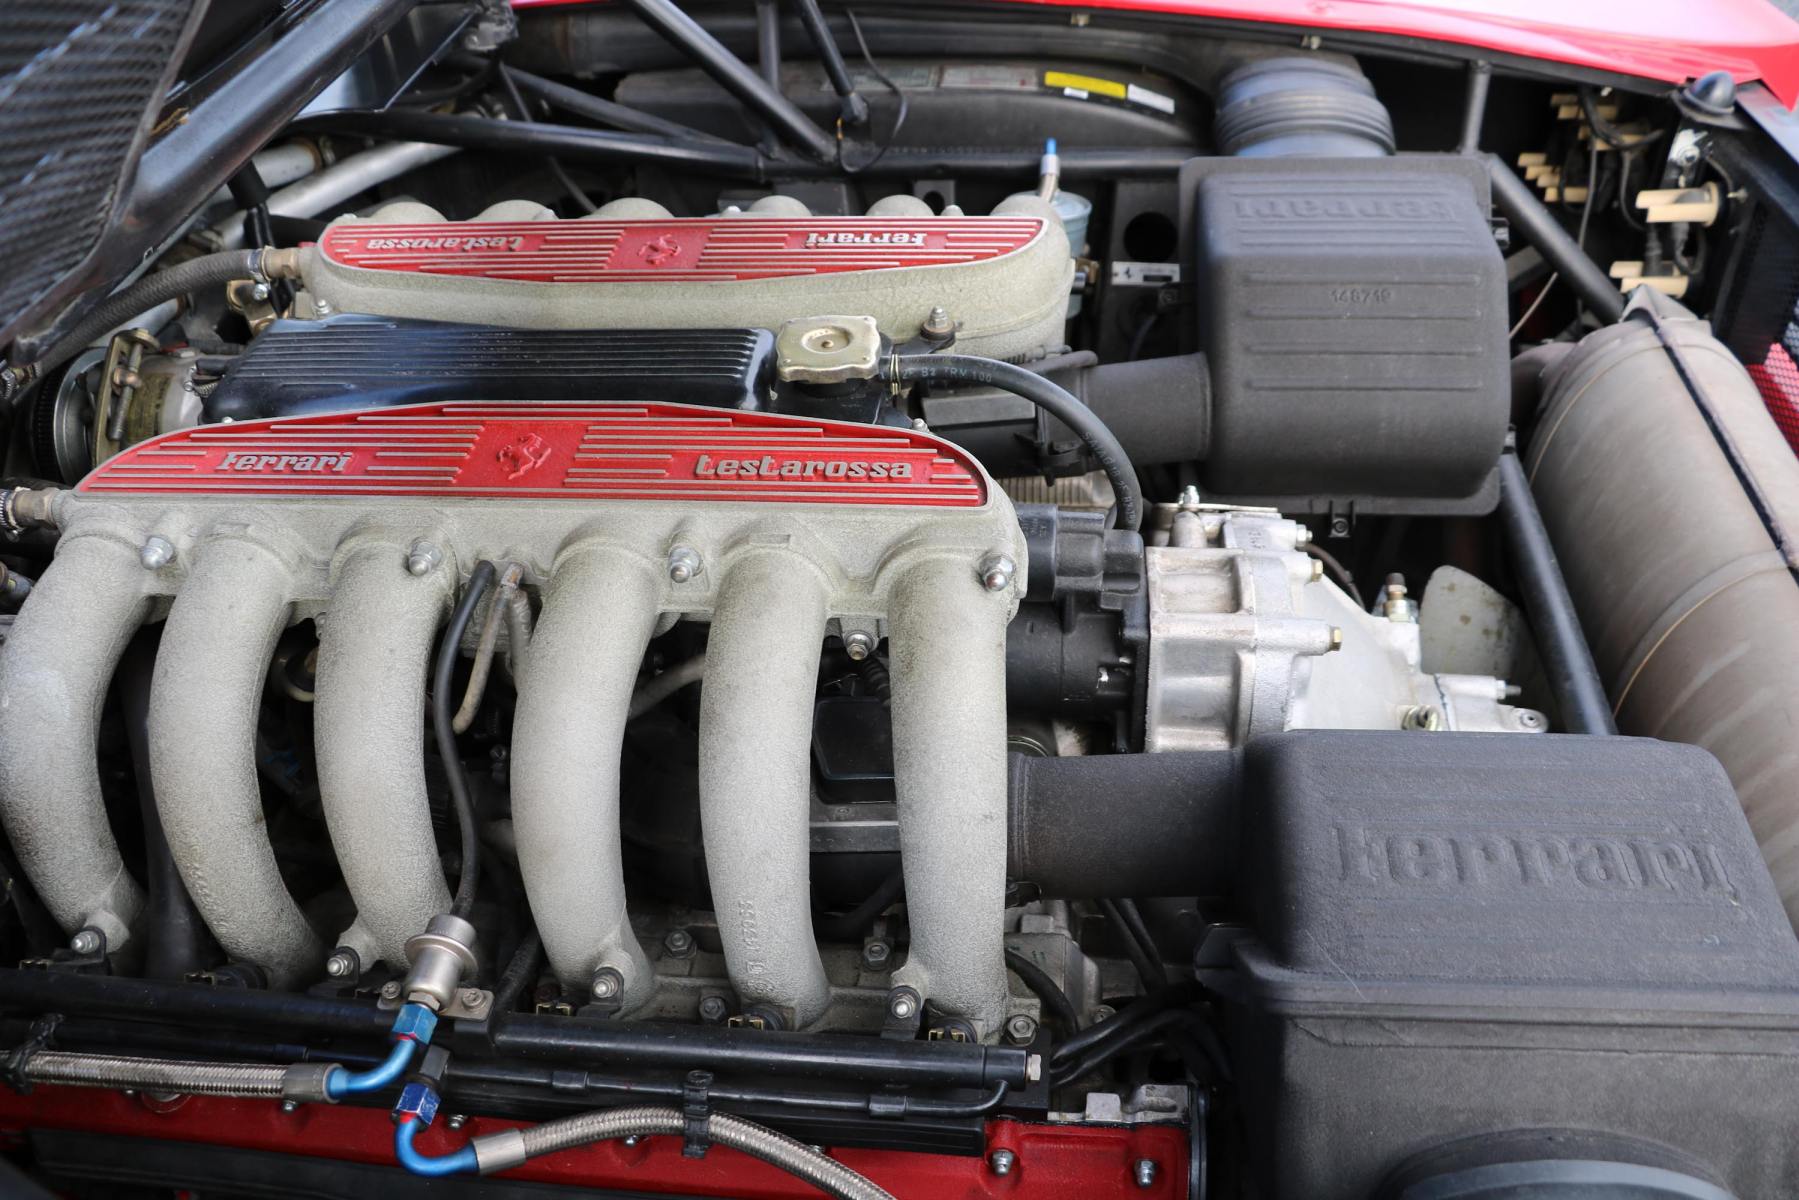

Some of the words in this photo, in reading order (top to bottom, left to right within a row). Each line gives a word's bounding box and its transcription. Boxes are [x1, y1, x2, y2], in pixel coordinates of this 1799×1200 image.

[367, 236, 524, 250] testarossa
[806, 232, 928, 248] Ferrari
[215, 451, 354, 471] Ferrari
[696, 454, 913, 479] testarossa
[1331, 819, 1739, 899] Ferrari
